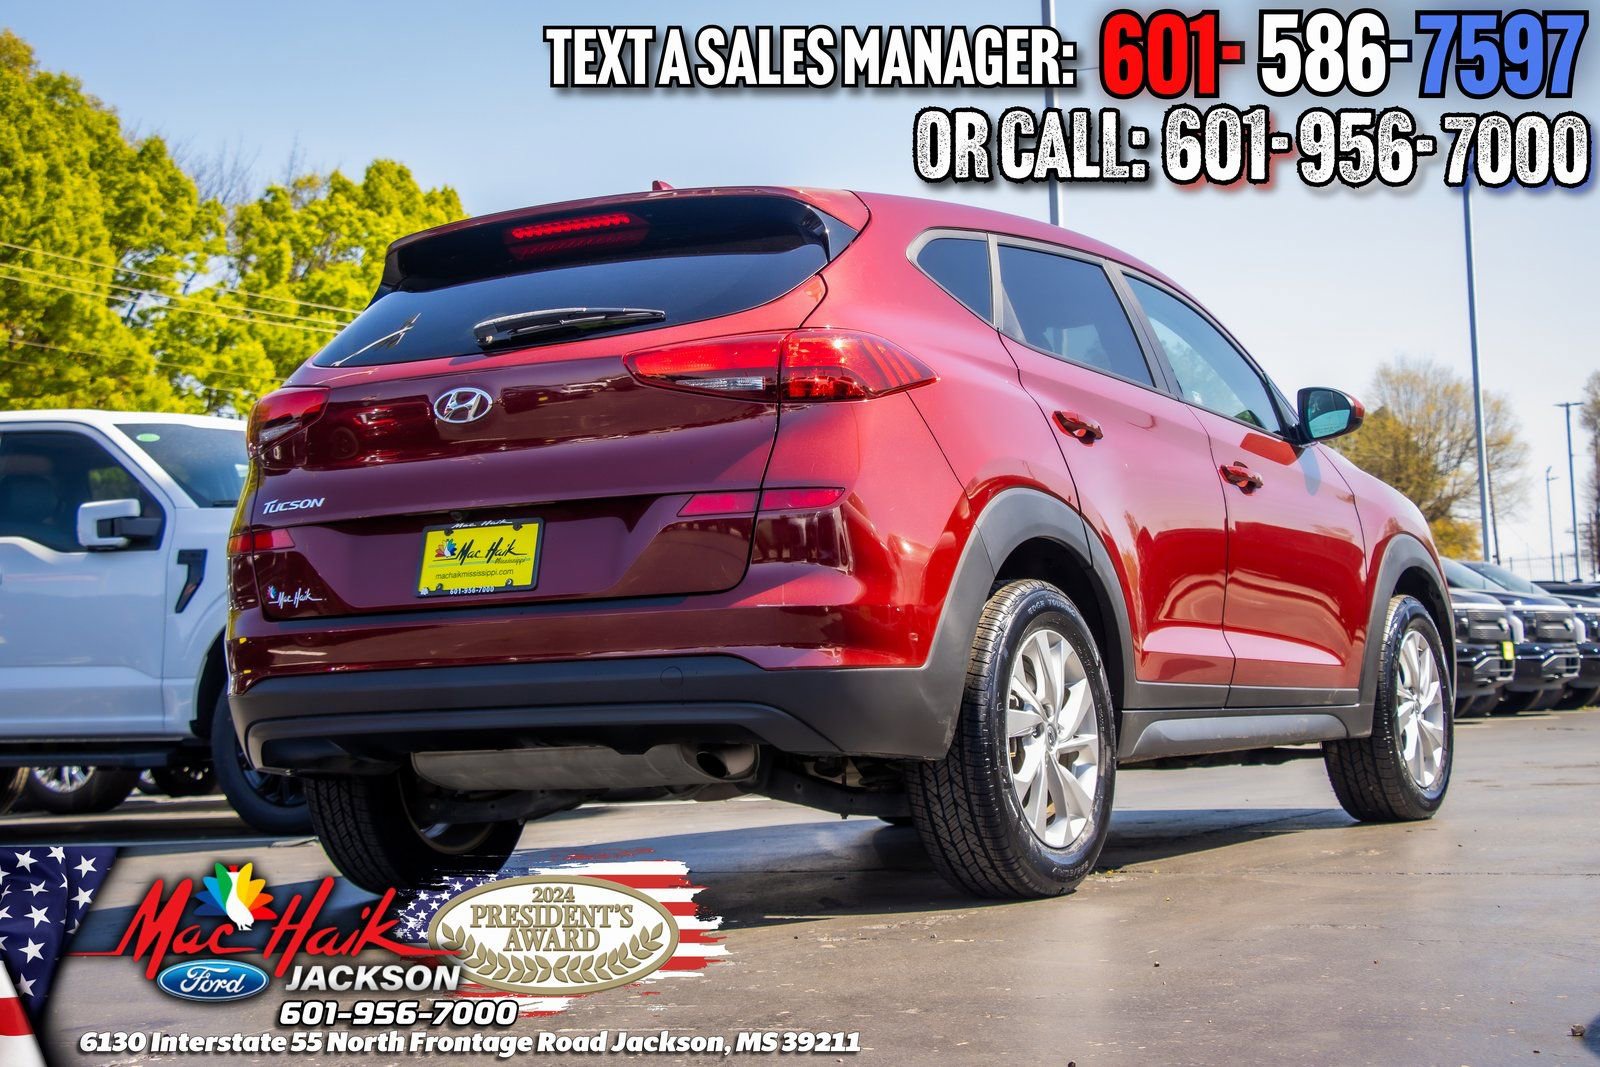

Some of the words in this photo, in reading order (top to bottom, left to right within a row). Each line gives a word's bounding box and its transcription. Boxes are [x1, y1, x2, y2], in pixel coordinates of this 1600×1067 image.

[454, 539, 481, 566] Mac
[485, 537, 527, 564] Haik
[435, 569, 514, 580] machaikmississippi.com
